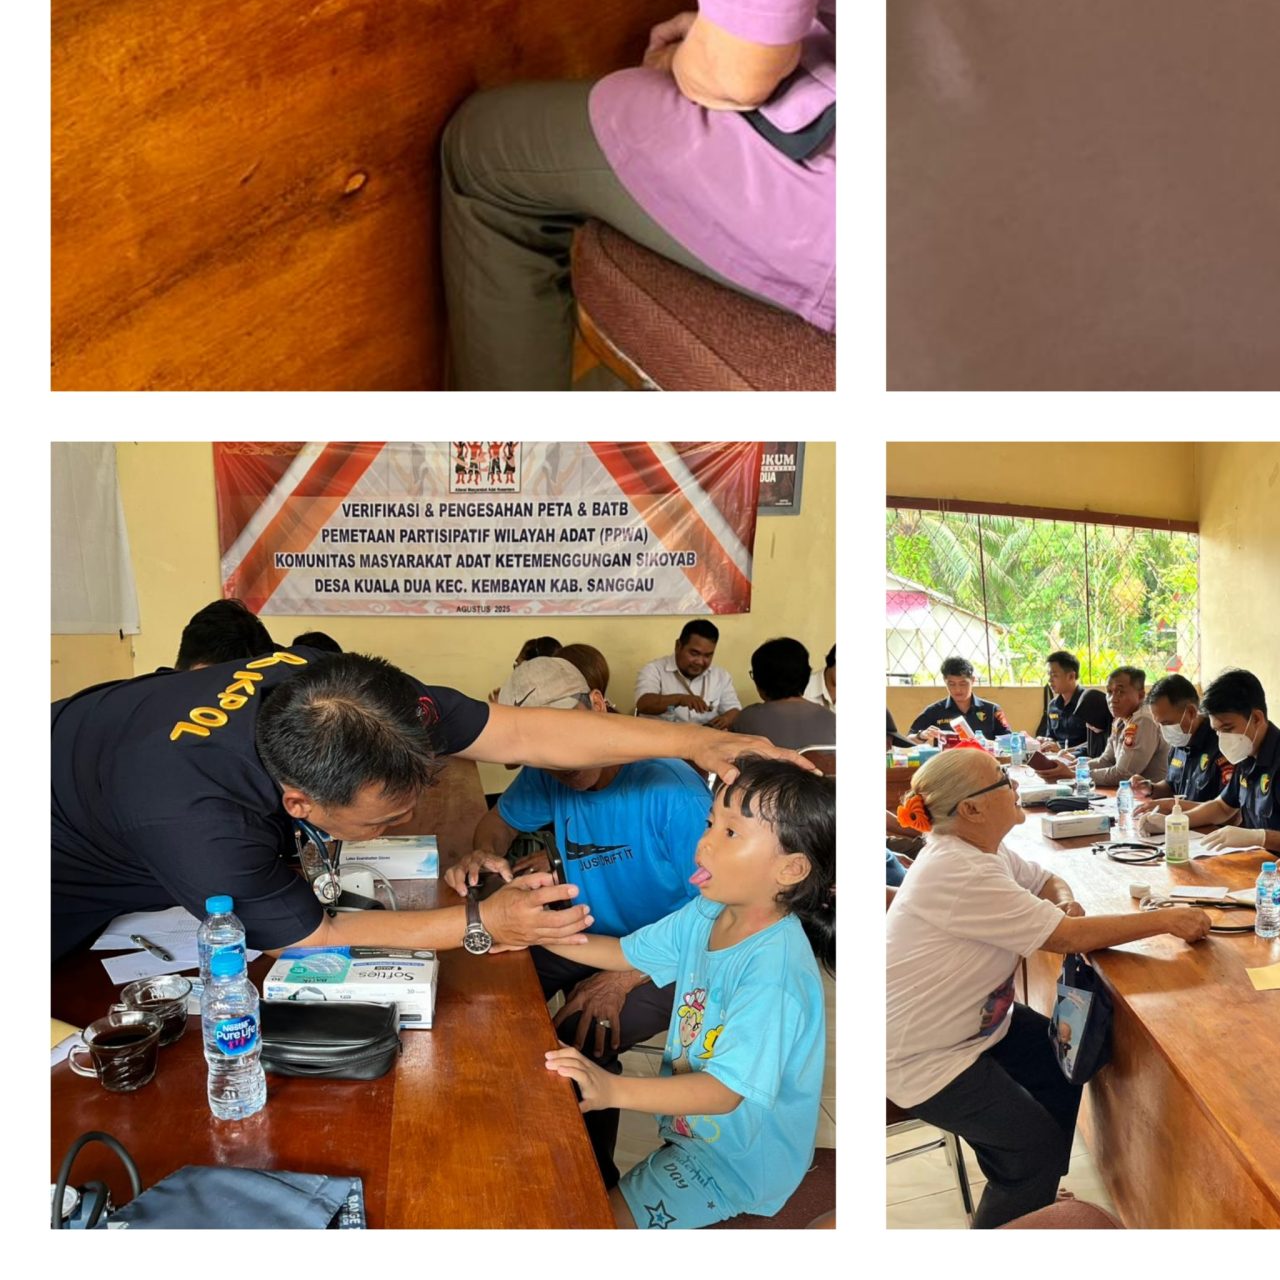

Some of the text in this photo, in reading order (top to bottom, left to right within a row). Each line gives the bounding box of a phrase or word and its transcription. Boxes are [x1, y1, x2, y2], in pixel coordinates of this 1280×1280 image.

[342, 502, 629, 518] VERIFIKASI & PENGESAHAN PETA & BATB
[321, 527, 648, 545] PEMETAAN PARTISIPATIF WILAYAH ADAT (PPWA)
[275, 551, 696, 568] KOMUNITAS MASYARAKAT ADAT KETEMENGGUNGAN SIKOYAB
[314, 578, 655, 593] DESA KUALA DUA KEC. KEMBAYAN KAB. SANGGAU
[456, 605, 491, 614] AGUSTUS
[358, 970, 415, 982] Softies
[216, 1024, 256, 1041] Pure Life
